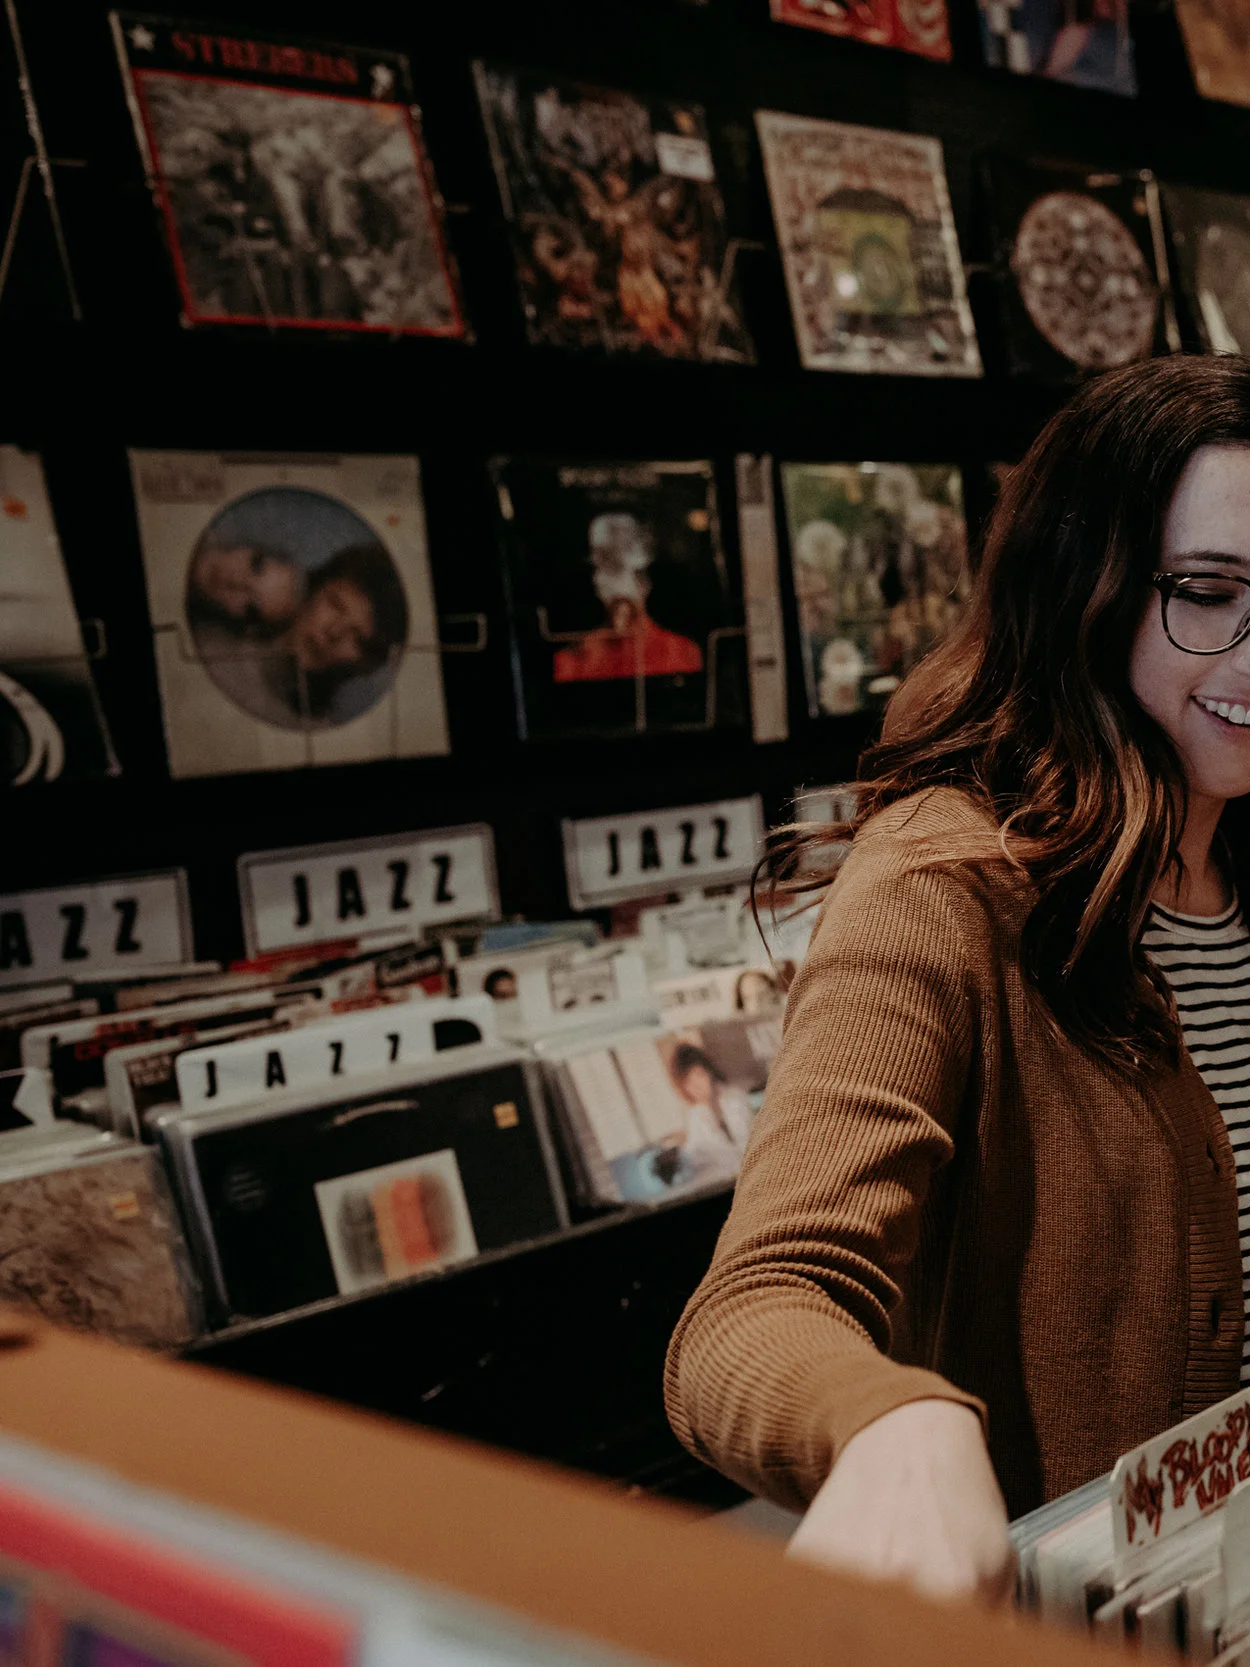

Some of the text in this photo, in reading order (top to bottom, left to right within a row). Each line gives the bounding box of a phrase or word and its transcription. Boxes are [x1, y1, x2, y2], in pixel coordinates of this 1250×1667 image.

[608, 817, 729, 876] JAZZ
[294, 854, 454, 927] JAZZ
[205, 1032, 399, 1098] JAZZ
